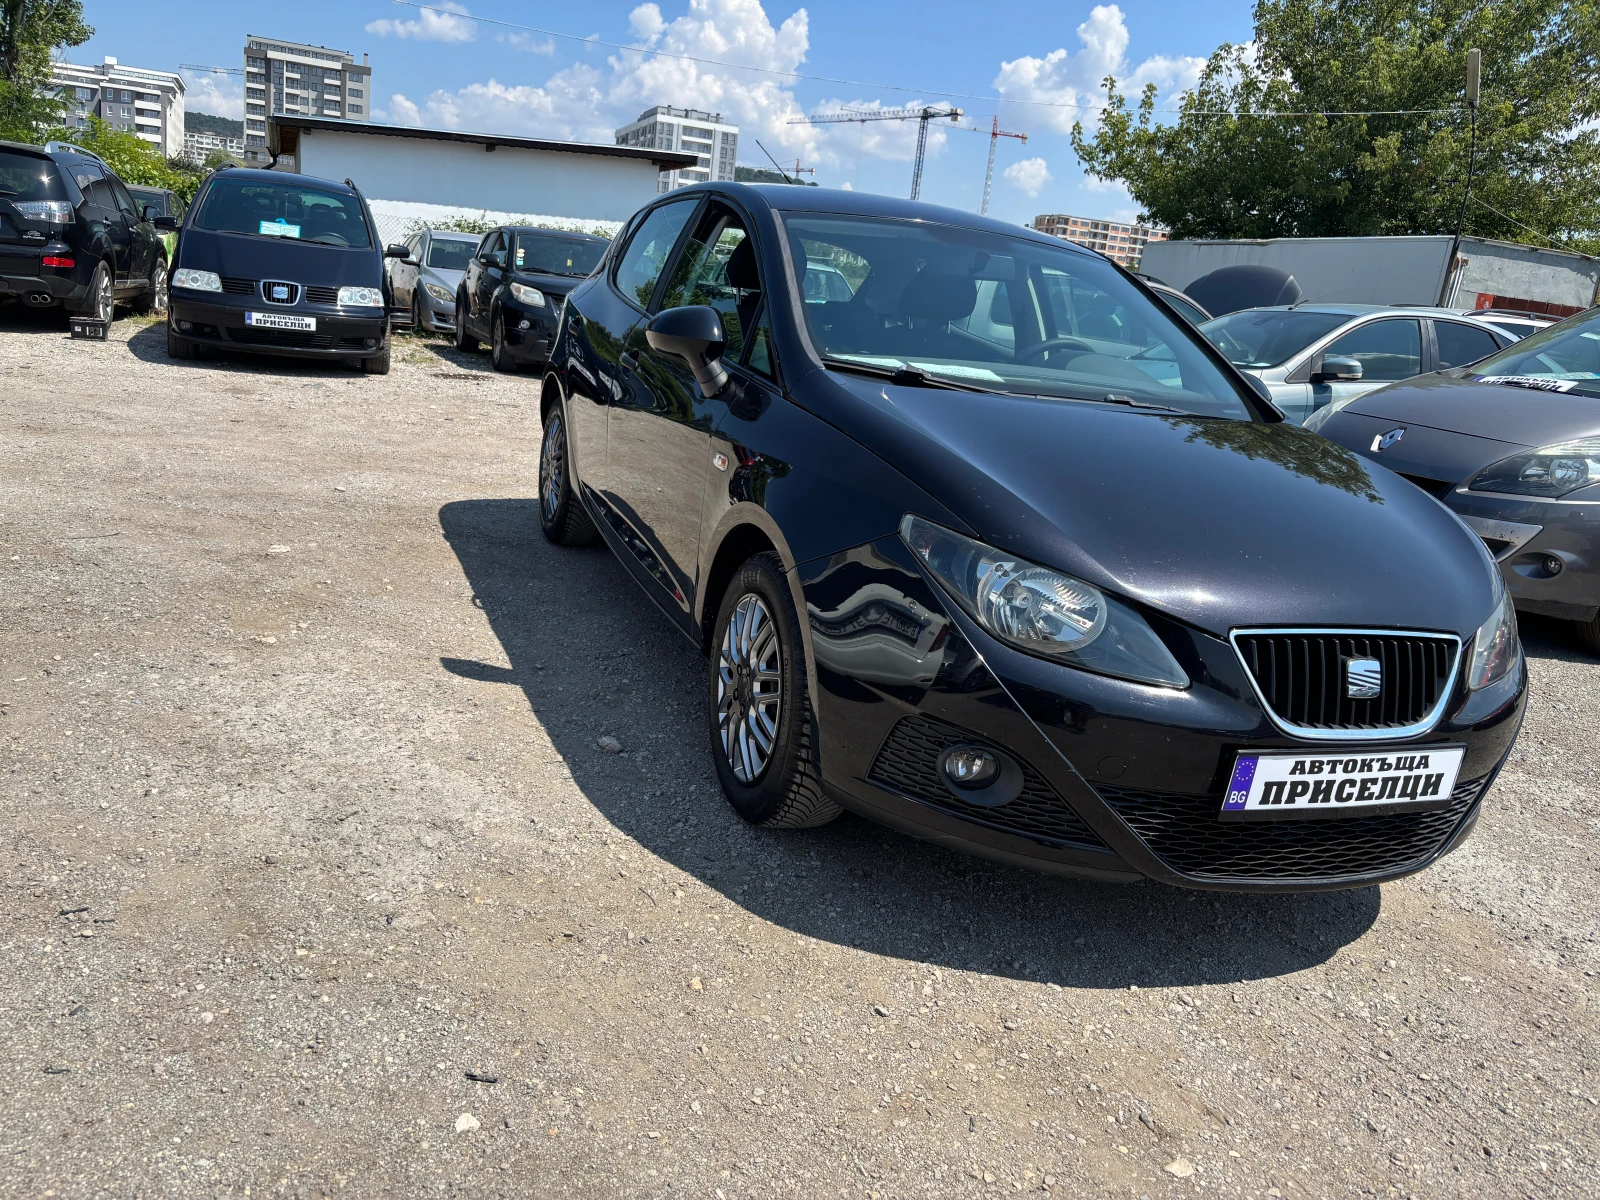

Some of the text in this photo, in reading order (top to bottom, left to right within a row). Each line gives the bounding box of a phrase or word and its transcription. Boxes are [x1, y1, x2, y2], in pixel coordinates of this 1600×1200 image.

[255, 318, 312, 330] ПРИСЕЛЦИ
[1288, 755, 1430, 776] АВТОКЪЩА
[1229, 790, 1246, 803] BG
[1258, 773, 1445, 806] ПРИСЕЛЦИ
